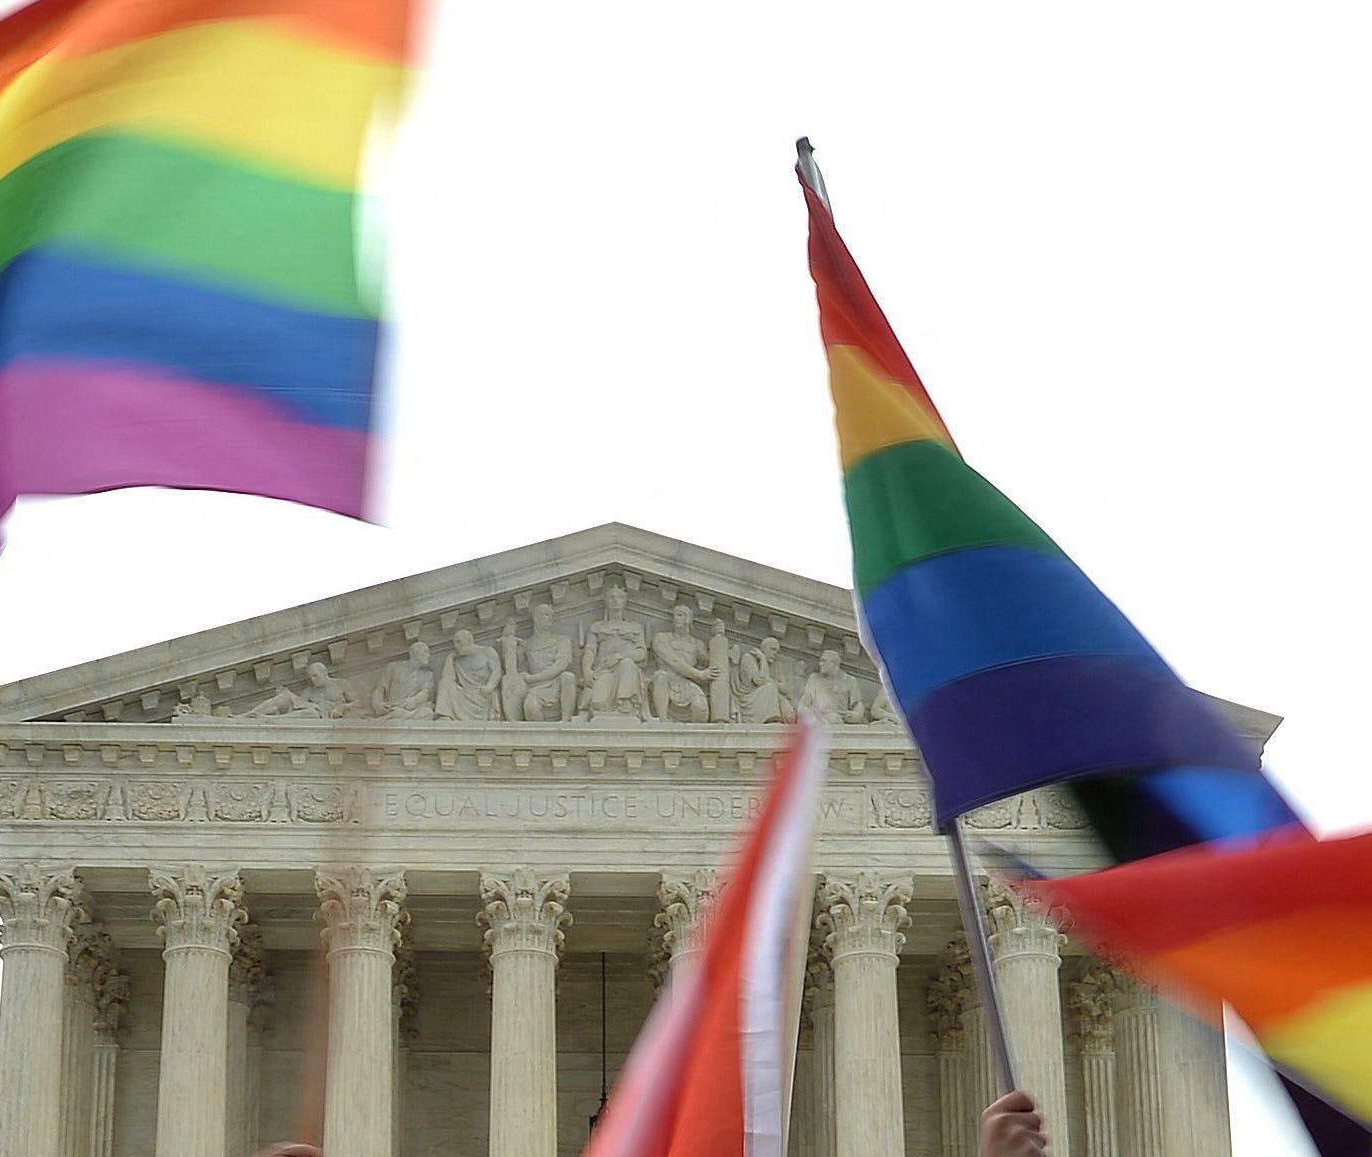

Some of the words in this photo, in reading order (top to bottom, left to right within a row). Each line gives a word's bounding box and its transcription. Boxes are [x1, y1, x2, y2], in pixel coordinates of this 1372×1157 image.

[384, 793, 497, 820] EQUAL
[505, 793, 638, 820] JUSTICE
[655, 796, 763, 820] UNDER
